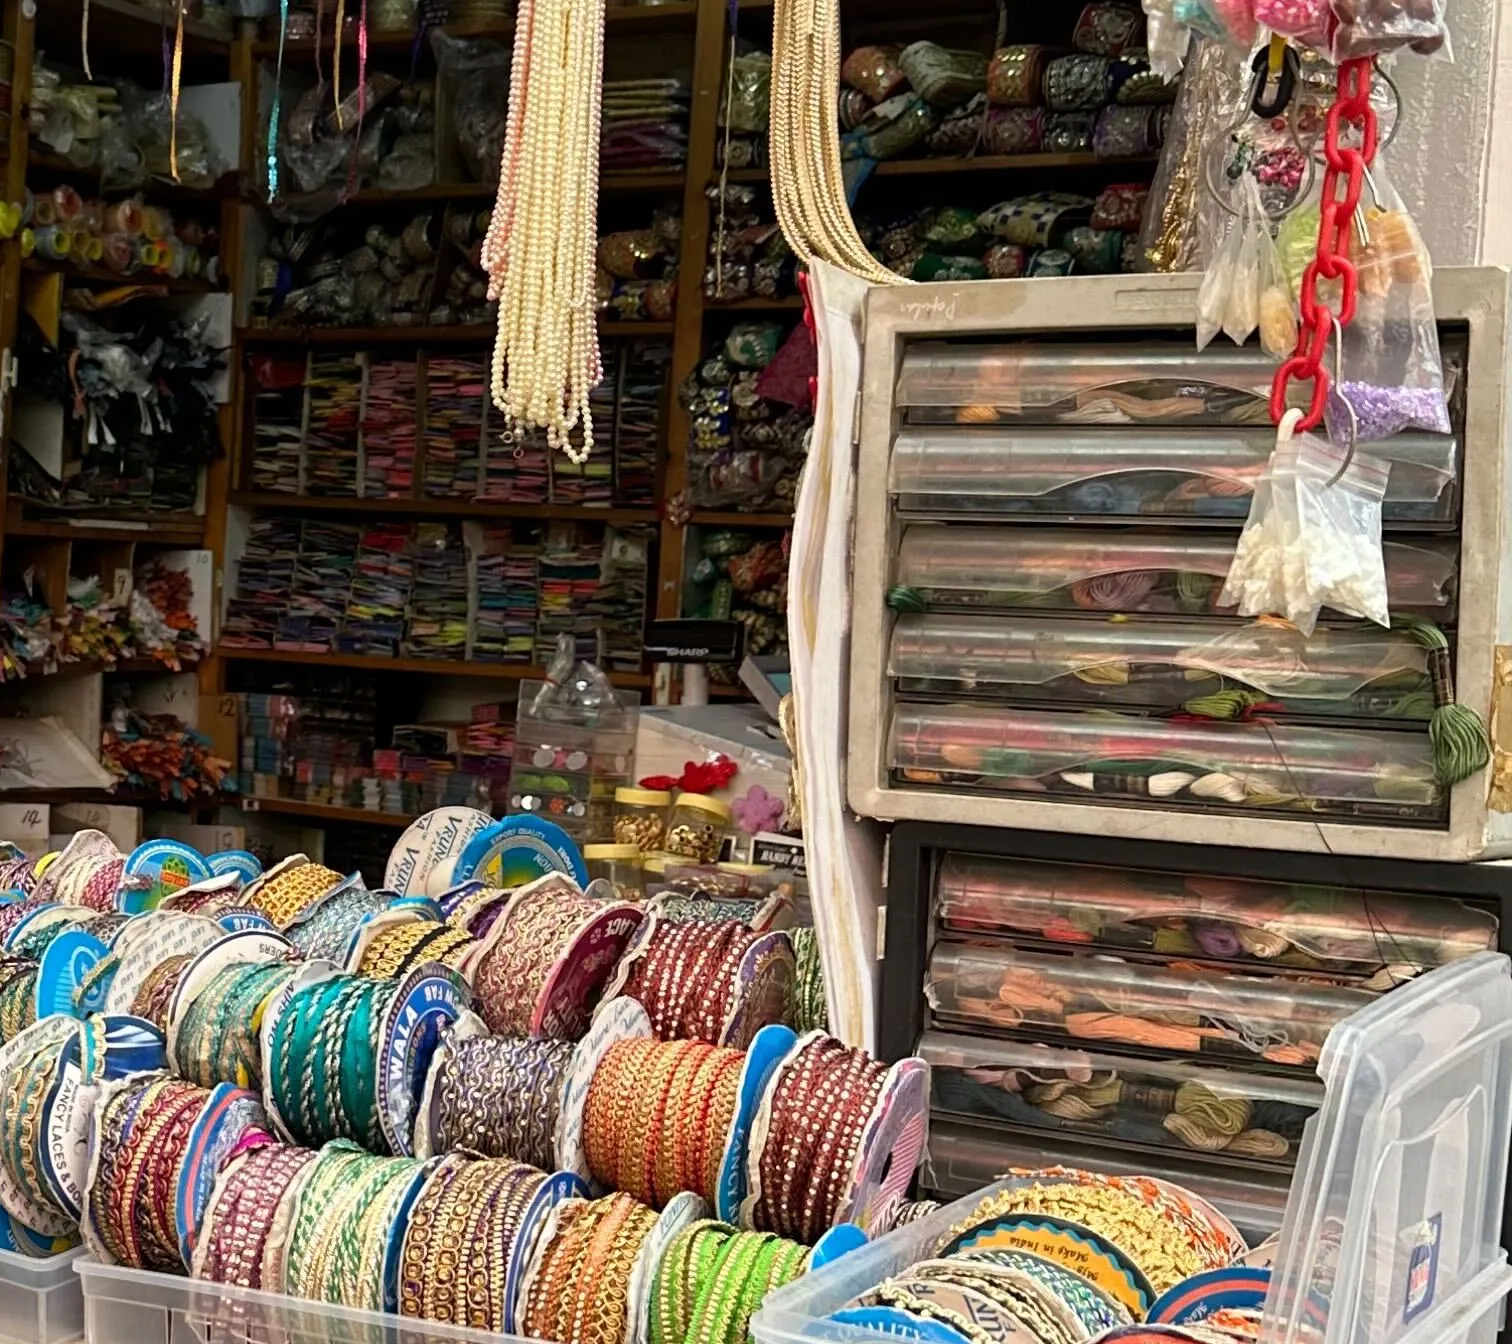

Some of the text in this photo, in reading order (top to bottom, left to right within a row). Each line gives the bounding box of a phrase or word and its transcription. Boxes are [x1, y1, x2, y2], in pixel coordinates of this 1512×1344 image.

[667, 647, 709, 656] SHARP
[604, 917, 637, 938] LACE
[54, 1076, 73, 1122] FANCY
[51, 1124, 68, 1170] LACES
[1008, 1236, 1038, 1253] India
[836, 1321, 928, 1344] QUALITY
